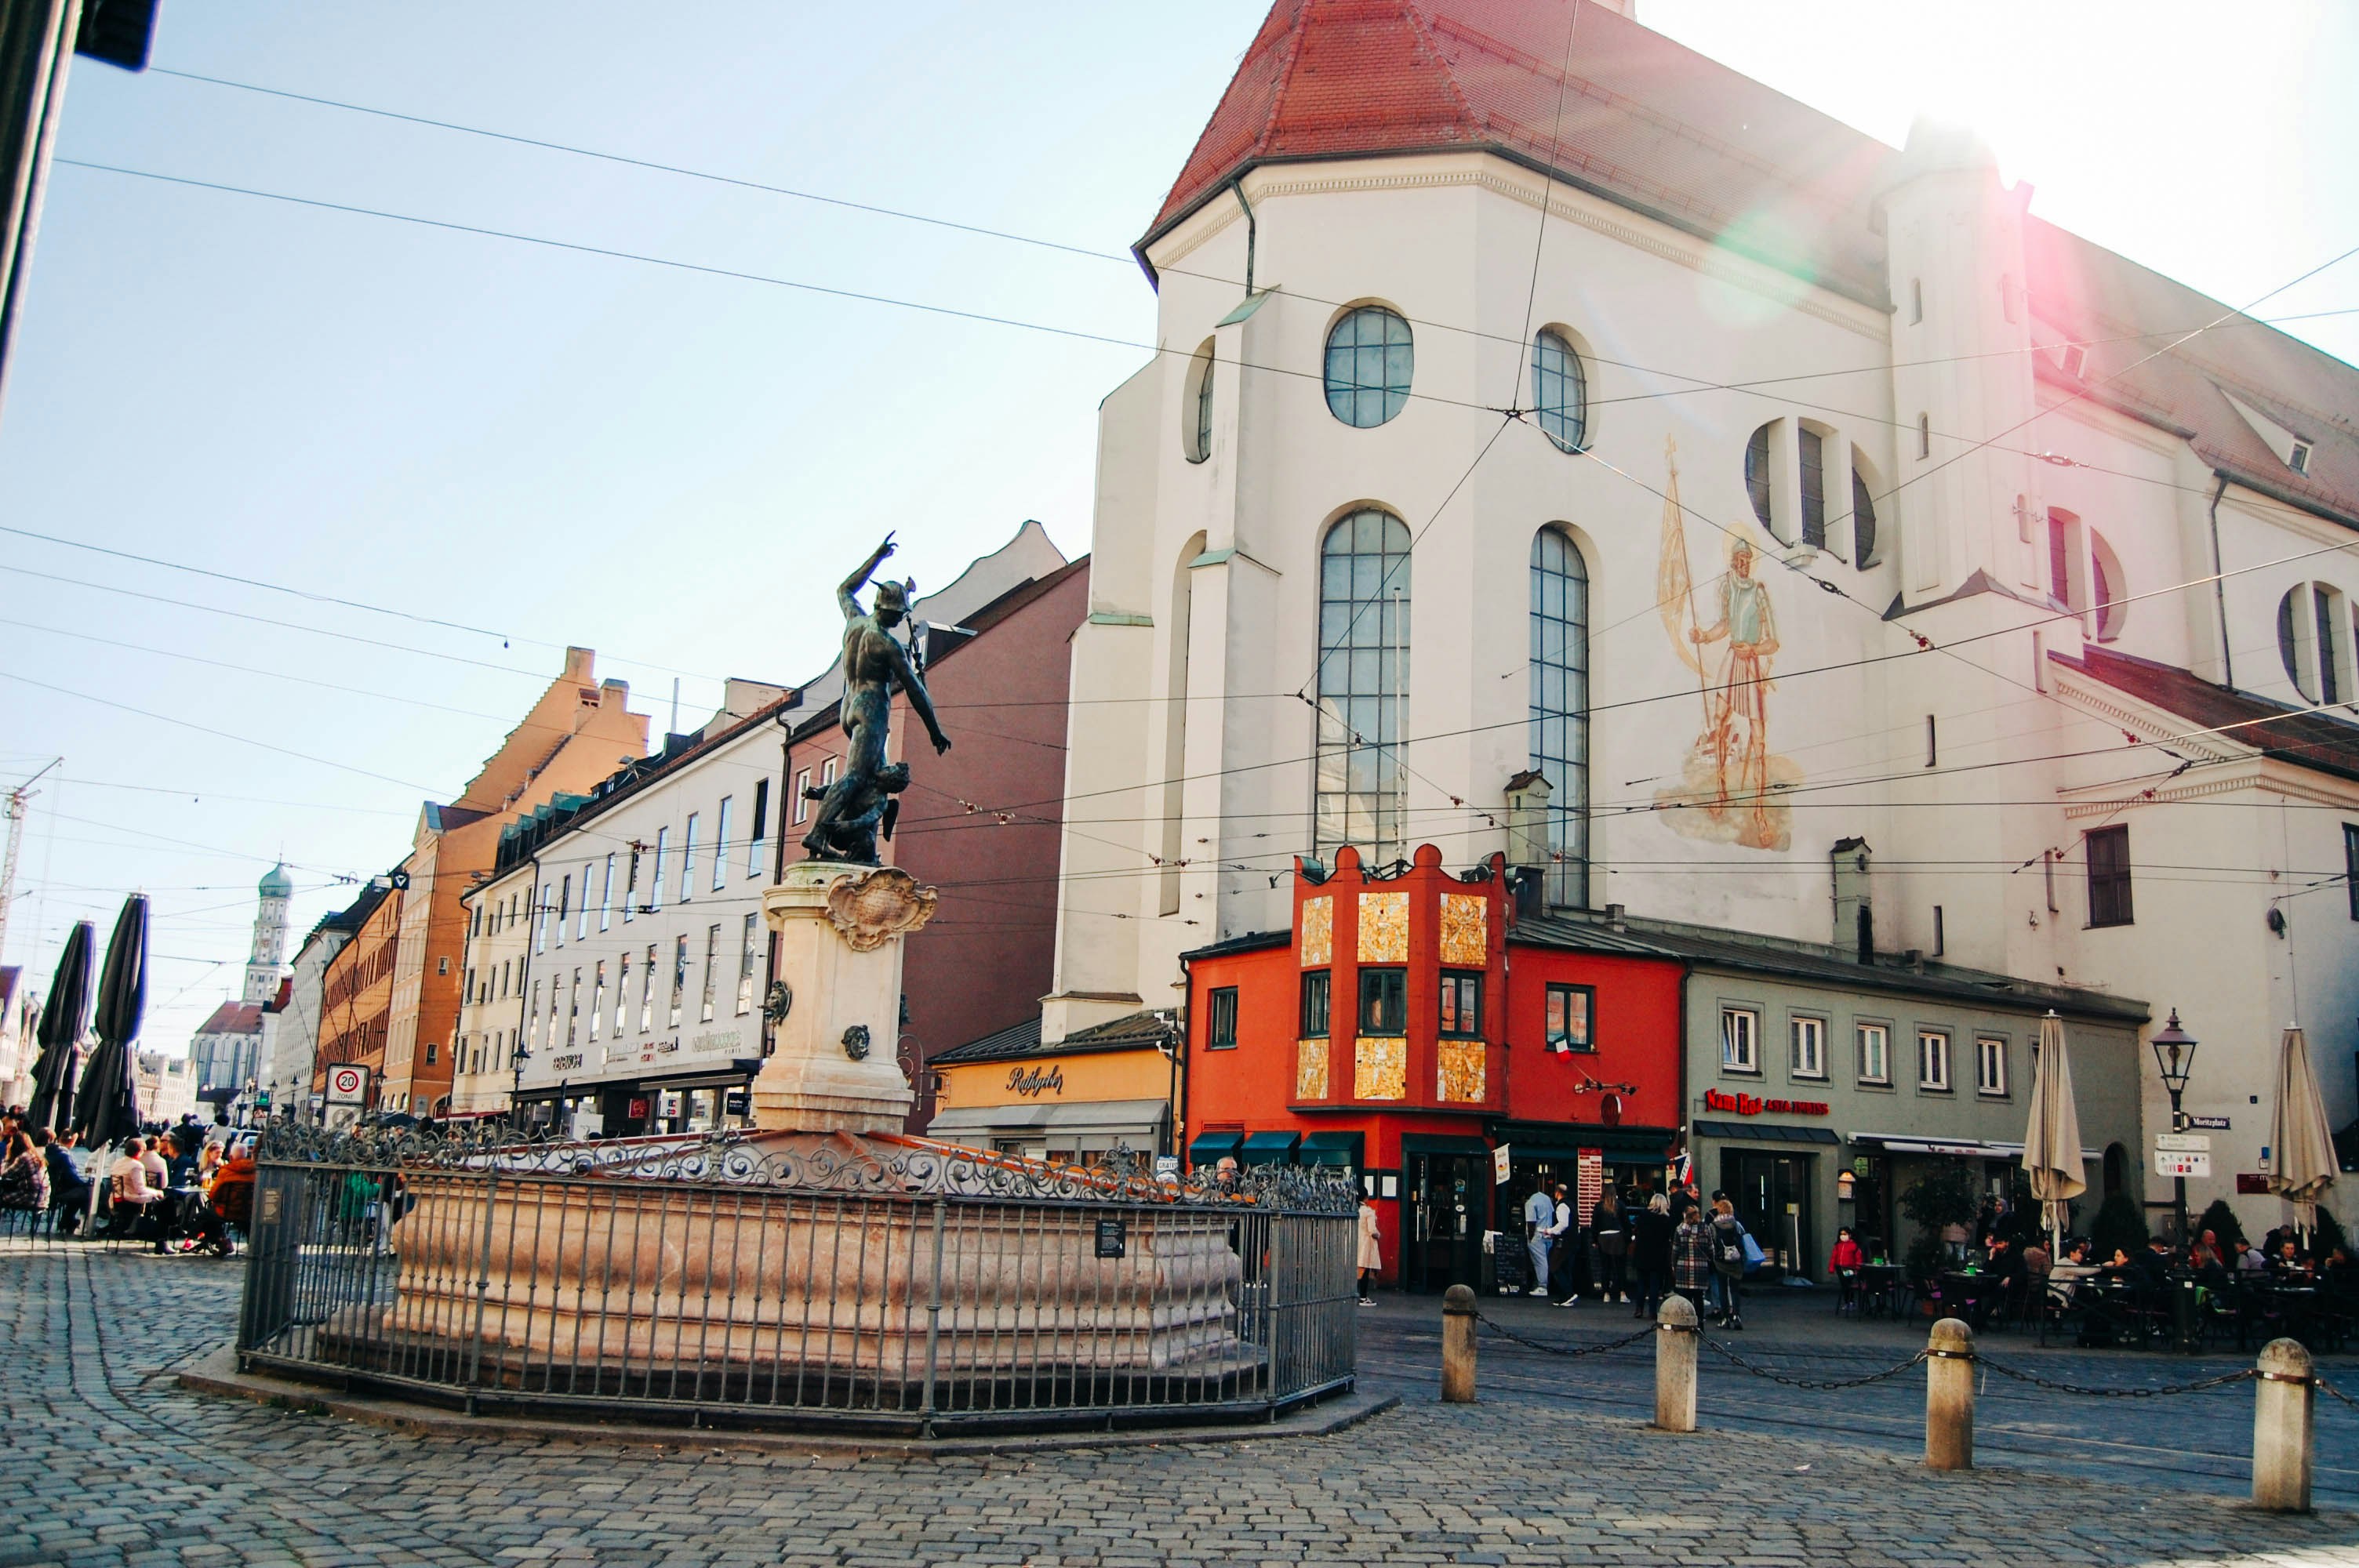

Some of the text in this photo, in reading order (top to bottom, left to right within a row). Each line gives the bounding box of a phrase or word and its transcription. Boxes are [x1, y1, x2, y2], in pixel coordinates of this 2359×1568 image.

[341, 1076, 354, 1086] 20
[1706, 1087, 1736, 1112] Nam
[1765, 1098, 1792, 1113] ASIA
[1793, 1100, 1830, 1116] IMBISS
[2193, 1117, 2226, 1127] Moritzplatz
